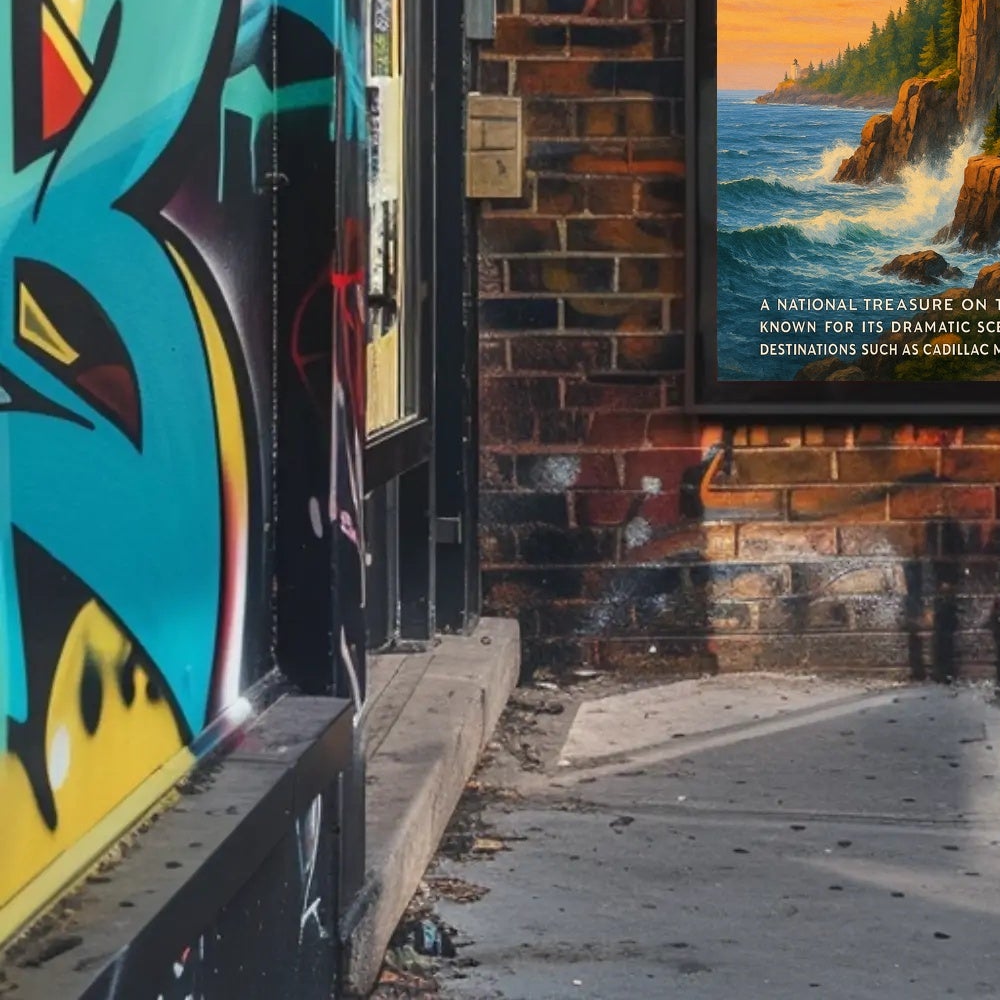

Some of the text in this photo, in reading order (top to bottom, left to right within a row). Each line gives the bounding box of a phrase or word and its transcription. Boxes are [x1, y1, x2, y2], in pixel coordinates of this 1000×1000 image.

[760, 298, 770, 311] A
[777, 298, 858, 311] NATIONAL
[863, 298, 953, 311] TREASURE
[961, 298, 988, 311] ON
[760, 321, 817, 333] KNOWN
[825, 321, 854, 333] FOR
[862, 321, 884, 333] ITS
[891, 321, 971, 333] DRAMATIC
[760, 343, 857, 356] DESTINATIONS
[861, 343, 898, 356] SUCH
[902, 343, 919, 356] AS
[923, 343, 989, 356] CADILLAC
